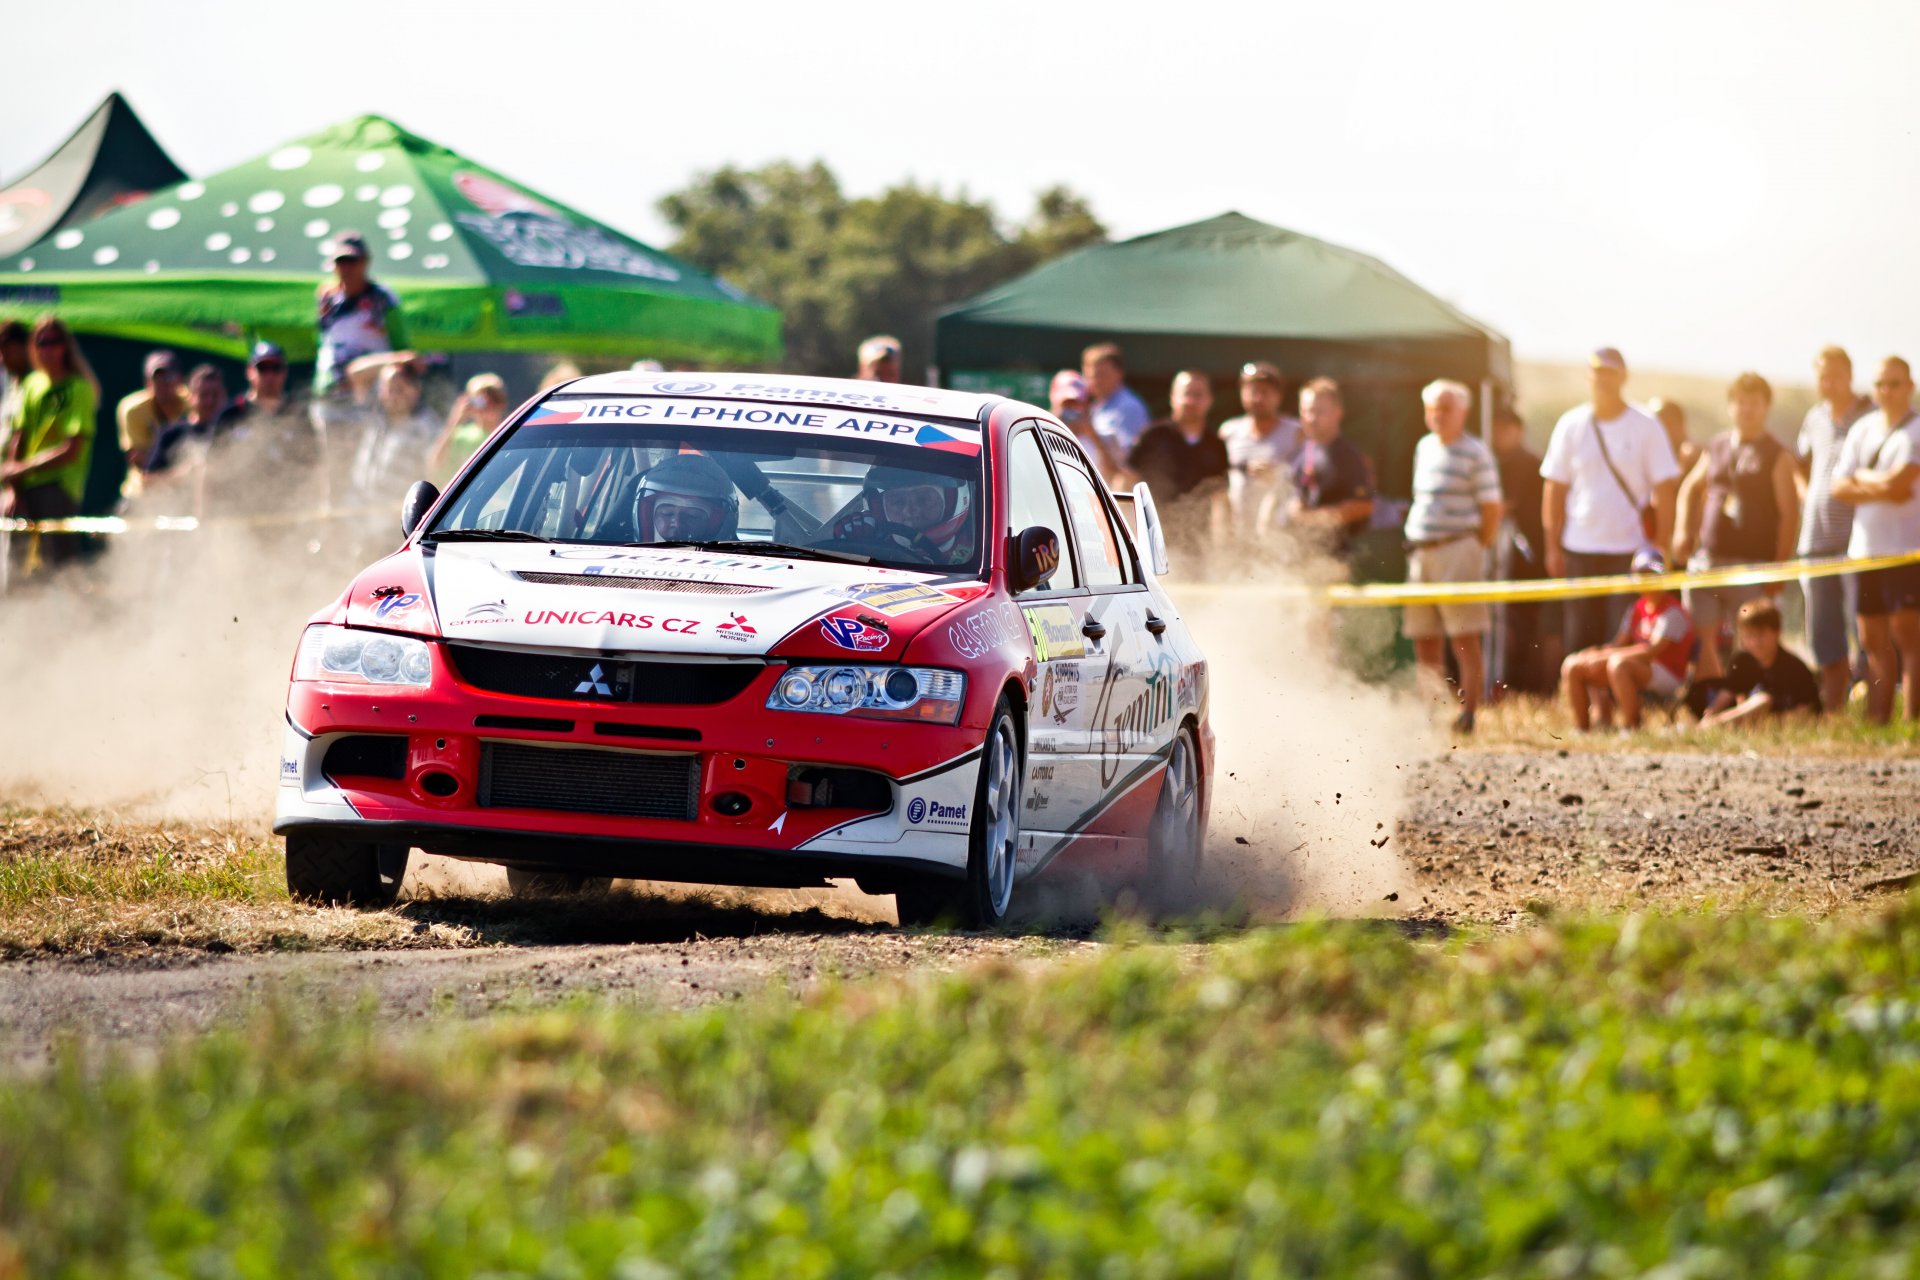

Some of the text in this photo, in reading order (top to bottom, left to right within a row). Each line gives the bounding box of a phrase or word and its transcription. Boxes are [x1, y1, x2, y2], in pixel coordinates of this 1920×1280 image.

[732, 383, 888, 404] Pamet
[587, 404, 915, 436] IRC I-PHONE APP
[524, 611, 701, 635] UNICARS CZ
[818, 616, 866, 650] VP
[716, 629, 755, 639] MITSUBISHI
[719, 634, 748, 643] MOTORS
[854, 632, 886, 645] Racing
[929, 800, 967, 820] Pamet
